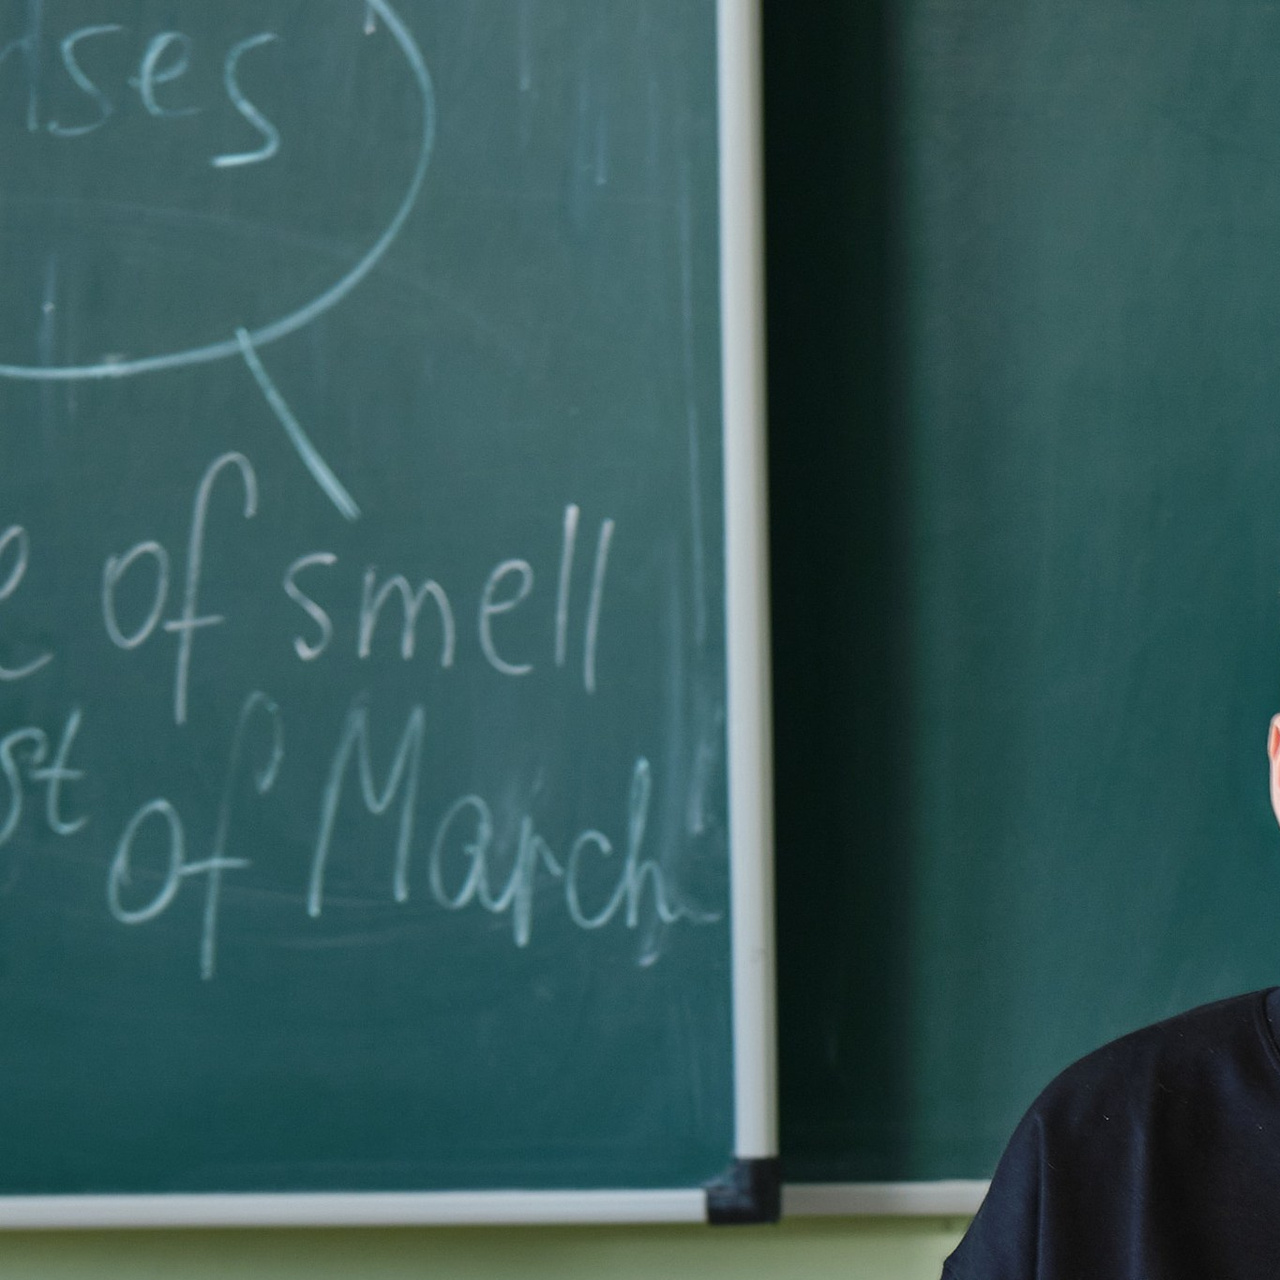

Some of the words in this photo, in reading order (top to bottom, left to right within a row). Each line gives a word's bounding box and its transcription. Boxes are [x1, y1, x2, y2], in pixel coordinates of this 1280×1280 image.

[103, 452, 257, 725] of
[283, 503, 614, 693] smell
[109, 690, 283, 980] of
[308, 705, 722, 966] March
